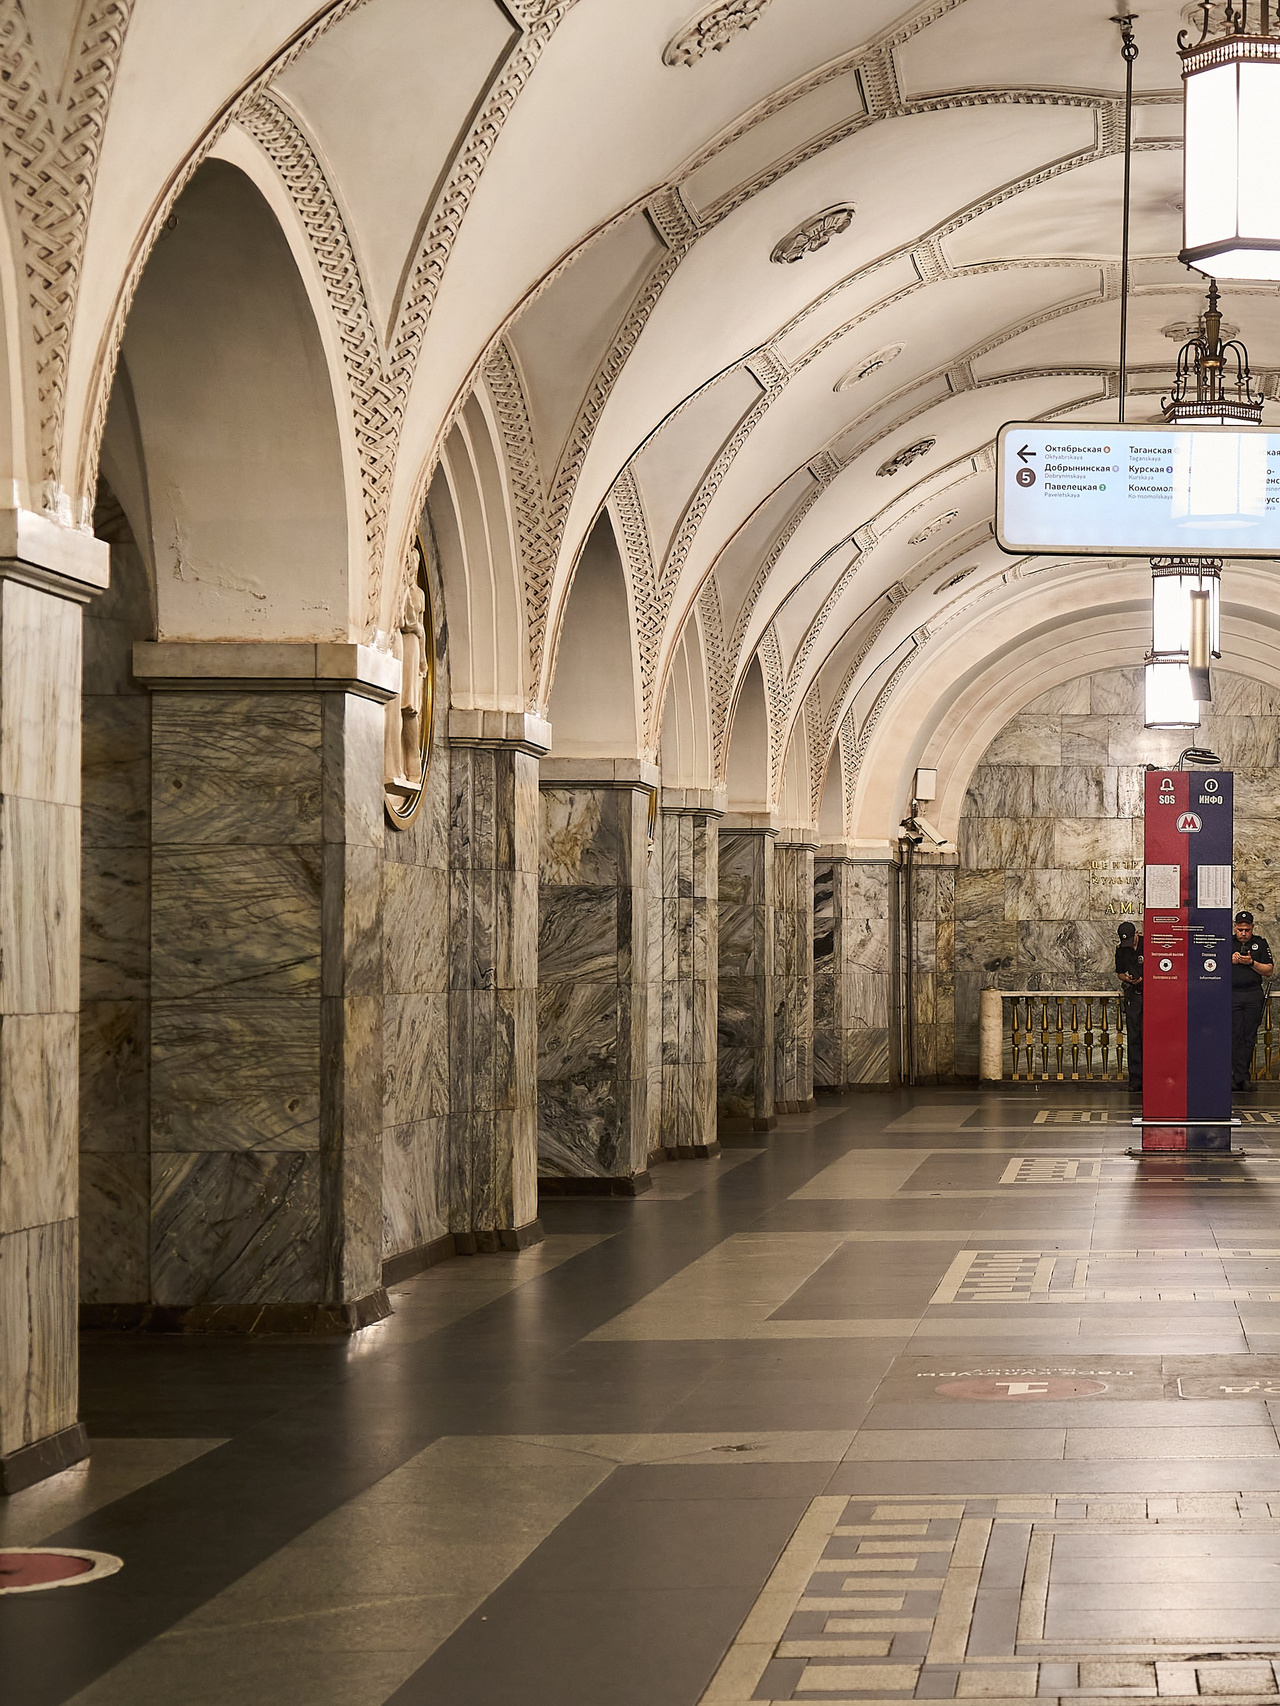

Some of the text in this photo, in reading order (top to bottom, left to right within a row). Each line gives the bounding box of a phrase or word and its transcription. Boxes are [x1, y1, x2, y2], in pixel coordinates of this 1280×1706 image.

[1045, 444, 1102, 454] Октябрьская
[1129, 446, 1172, 454] Таганская
[1045, 464, 1110, 473] Добрынинская
[1129, 466, 1164, 474] Курская
[1022, 472, 1031, 483] 5
[1045, 483, 1097, 491] Павелецкая
[1159, 795, 1175, 804] SOS
[1199, 795, 1223, 805] ИНФО
[995, 1382, 1049, 1395] 1
